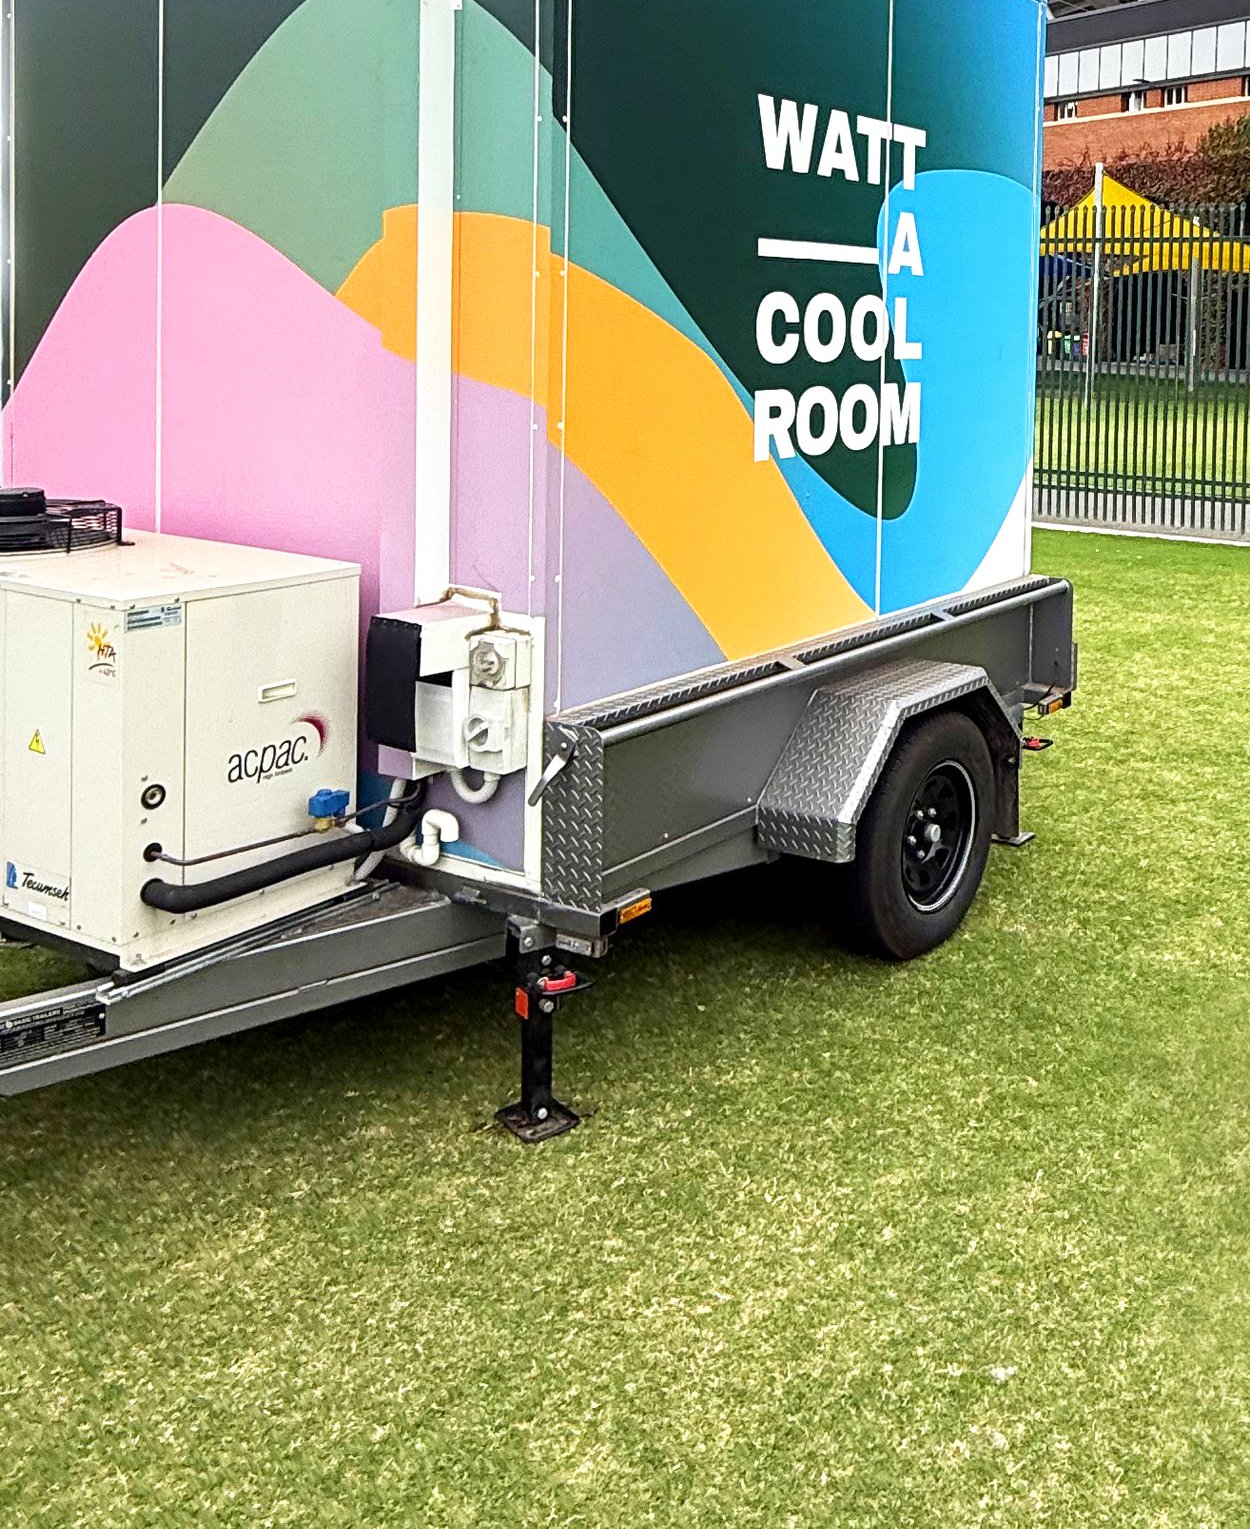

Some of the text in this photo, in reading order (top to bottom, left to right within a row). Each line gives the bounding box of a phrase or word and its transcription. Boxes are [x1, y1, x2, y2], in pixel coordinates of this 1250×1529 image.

[757, 93, 927, 191] WATT
[888, 212, 924, 276] A
[755, 290, 923, 365] COOL
[753, 382, 922, 462] ROOM
[22, 871, 70, 902] Tecumseh
